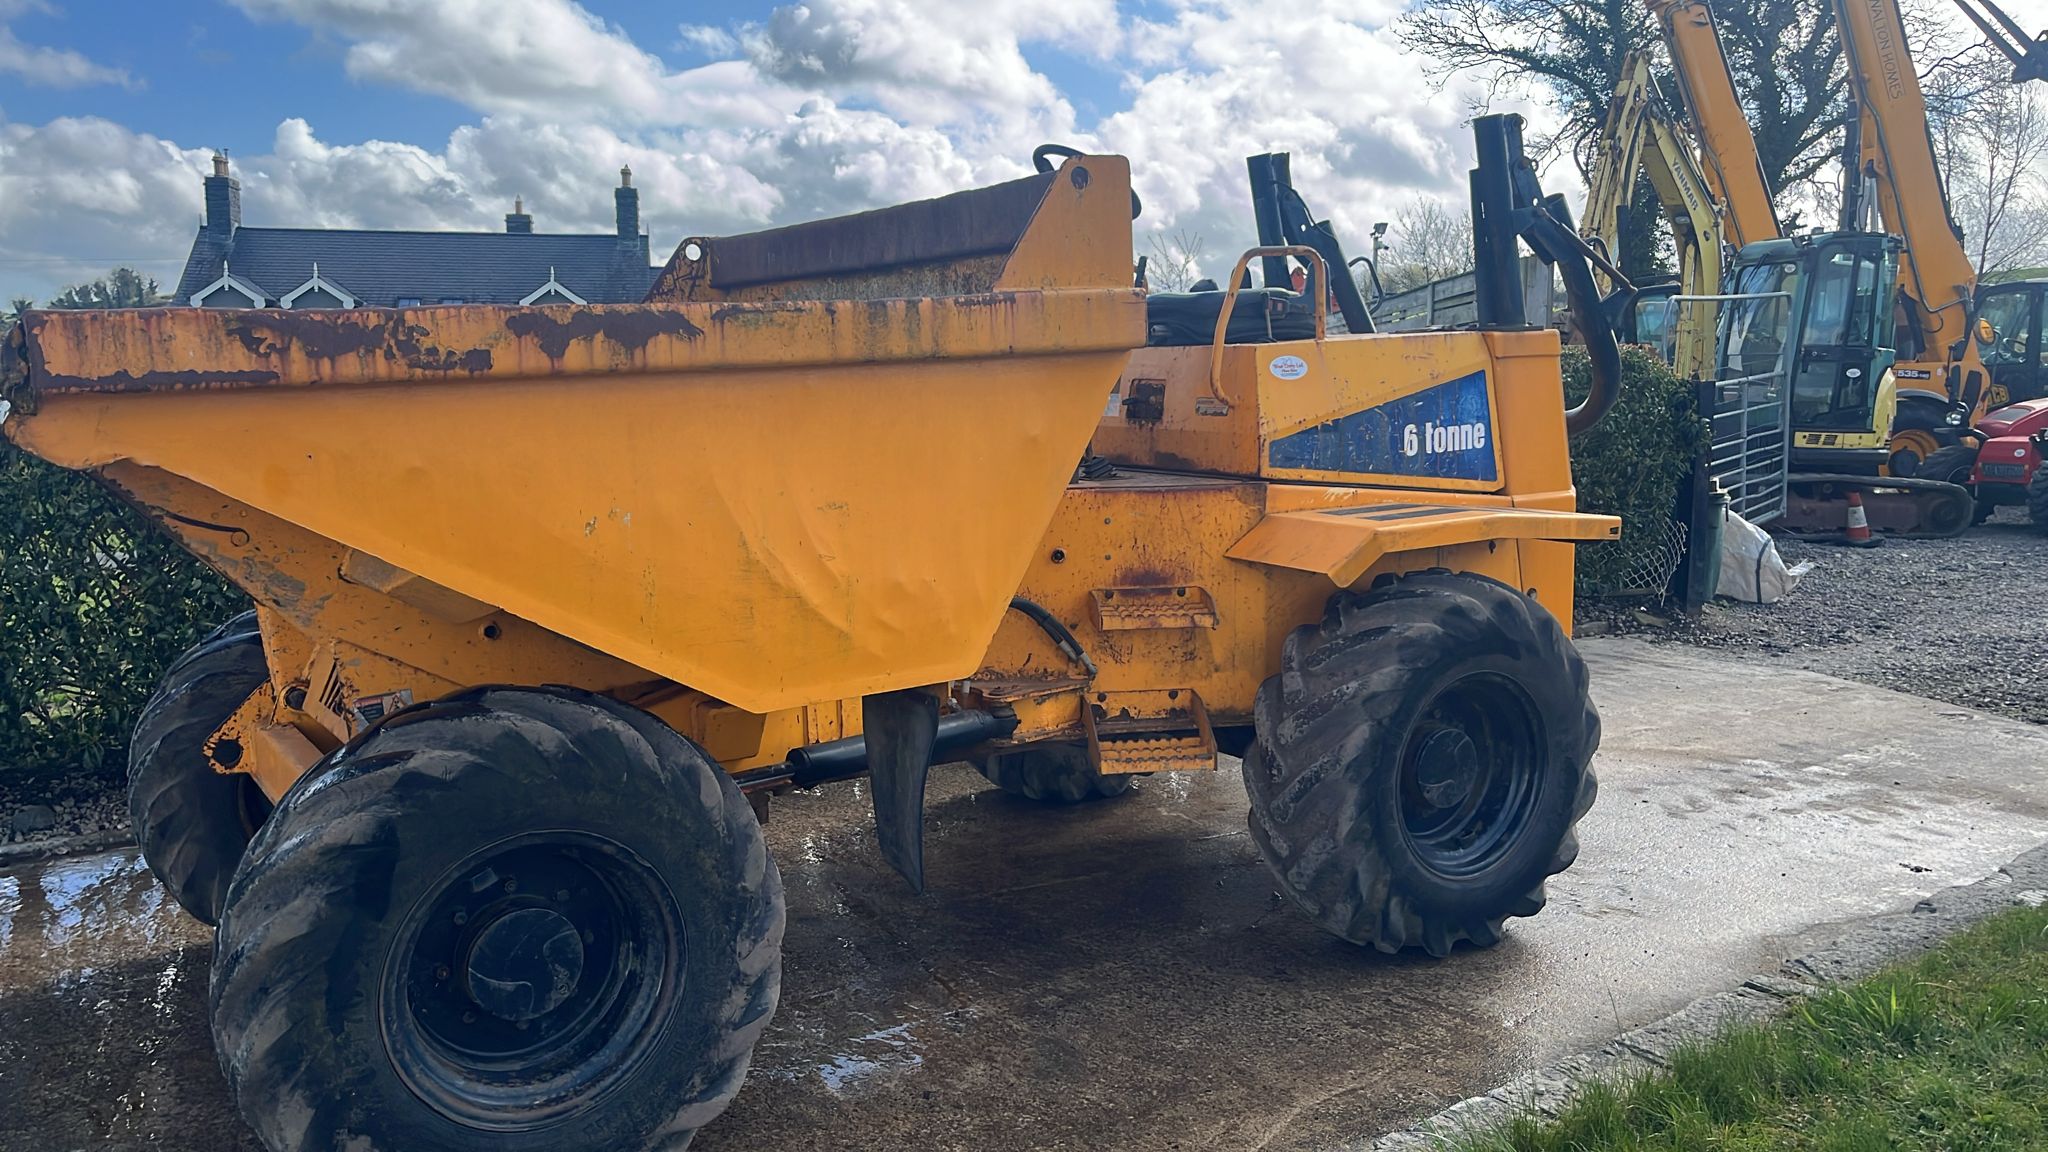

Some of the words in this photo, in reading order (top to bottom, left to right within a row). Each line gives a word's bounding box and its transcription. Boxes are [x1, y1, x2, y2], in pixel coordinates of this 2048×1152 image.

[1881, 50, 1903, 100] HOMES
[1672, 157, 1698, 210] YANMAR
[1404, 424, 1418, 456] 6
[1425, 422, 1485, 454] tonne
